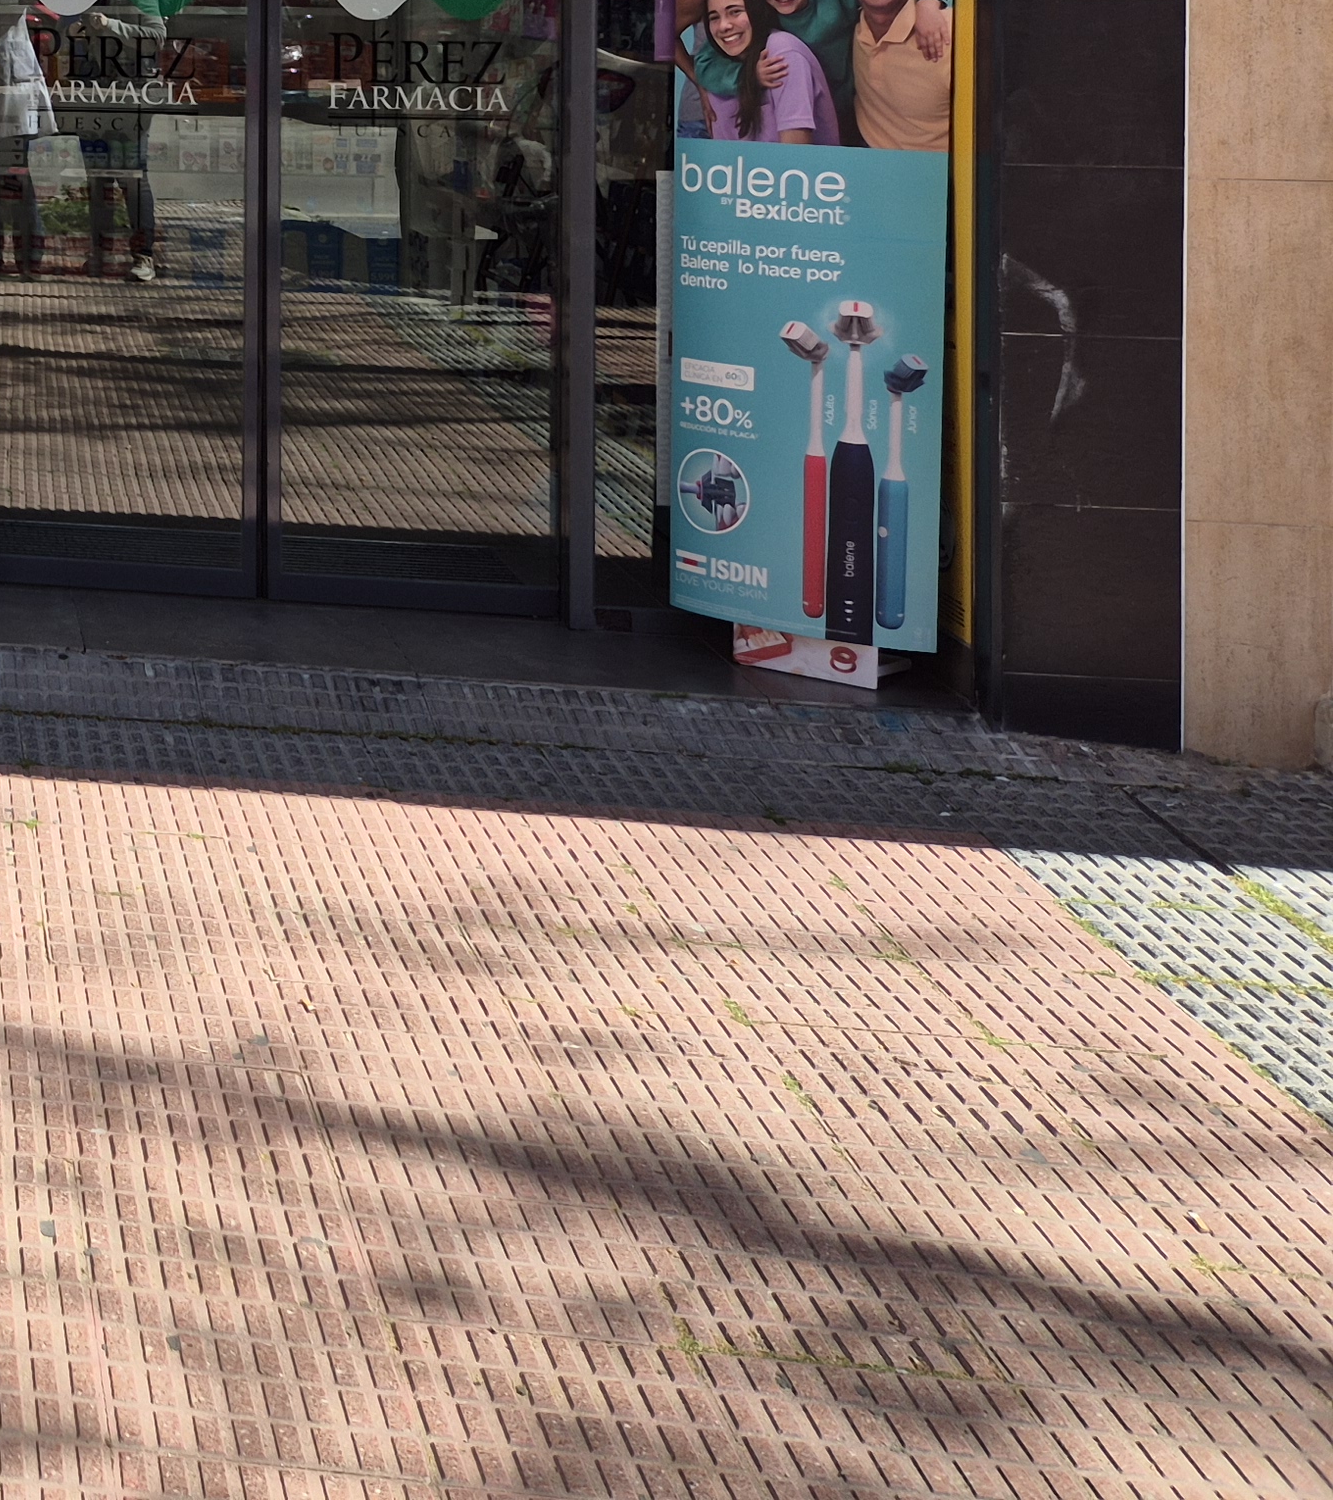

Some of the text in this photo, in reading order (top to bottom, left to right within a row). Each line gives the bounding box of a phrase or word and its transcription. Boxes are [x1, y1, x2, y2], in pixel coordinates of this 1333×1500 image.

[29, 26, 196, 78] PÉREZ
[329, 30, 506, 84] PÉREZ
[28, 75, 198, 106] FARMACIA
[328, 82, 510, 112] FARMACIA
[680, 153, 847, 202] balene
[720, 197, 846, 225] BY Bexident
[680, 235, 845, 266] Tú cepilla por fuera,
[680, 253, 841, 282] Balene lo hace por
[680, 272, 728, 290] dentro
[684, 361, 715, 373] EFICACIA
[712, 375, 723, 383] EN
[680, 395, 753, 429] +80%
[824, 394, 835, 426] Adulto
[867, 399, 878, 431] Sónica
[717, 428, 728, 436] DE
[710, 557, 768, 588] ISDIN
[843, 540, 856, 578] balene
[675, 571, 768, 601] LOVE YOUR SKIN
